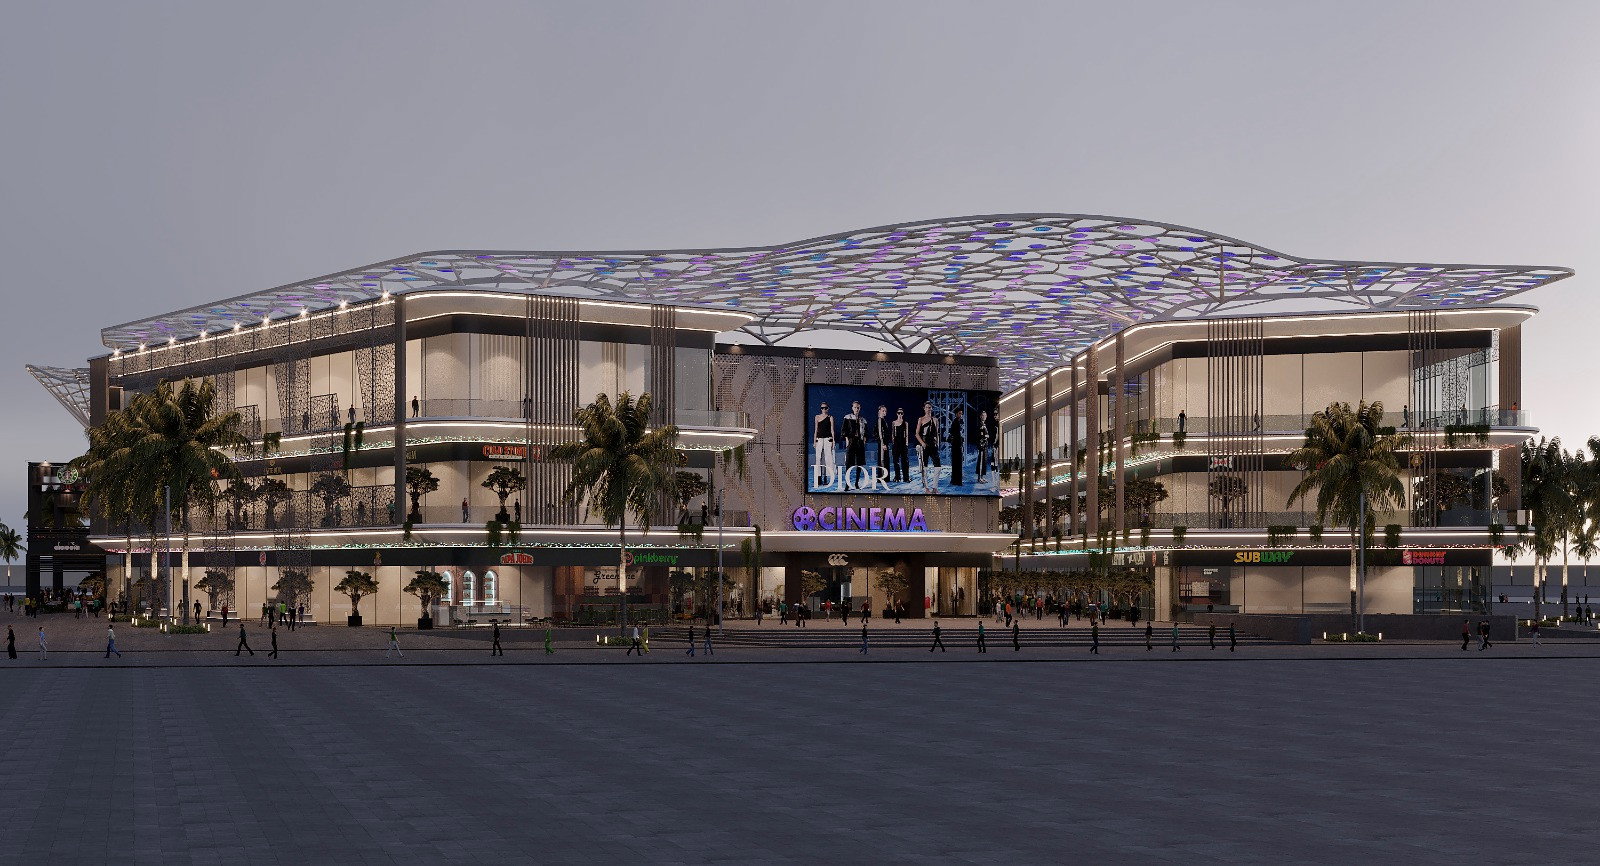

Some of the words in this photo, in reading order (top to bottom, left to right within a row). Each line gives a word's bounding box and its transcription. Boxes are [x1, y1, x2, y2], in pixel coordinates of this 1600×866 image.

[811, 464, 892, 491] DIOR
[818, 506, 929, 531] CINEMA
[633, 552, 677, 565] pinkberry
[1233, 551, 1295, 563] SUBWAY
[1412, 557, 1445, 565] DONUTS
